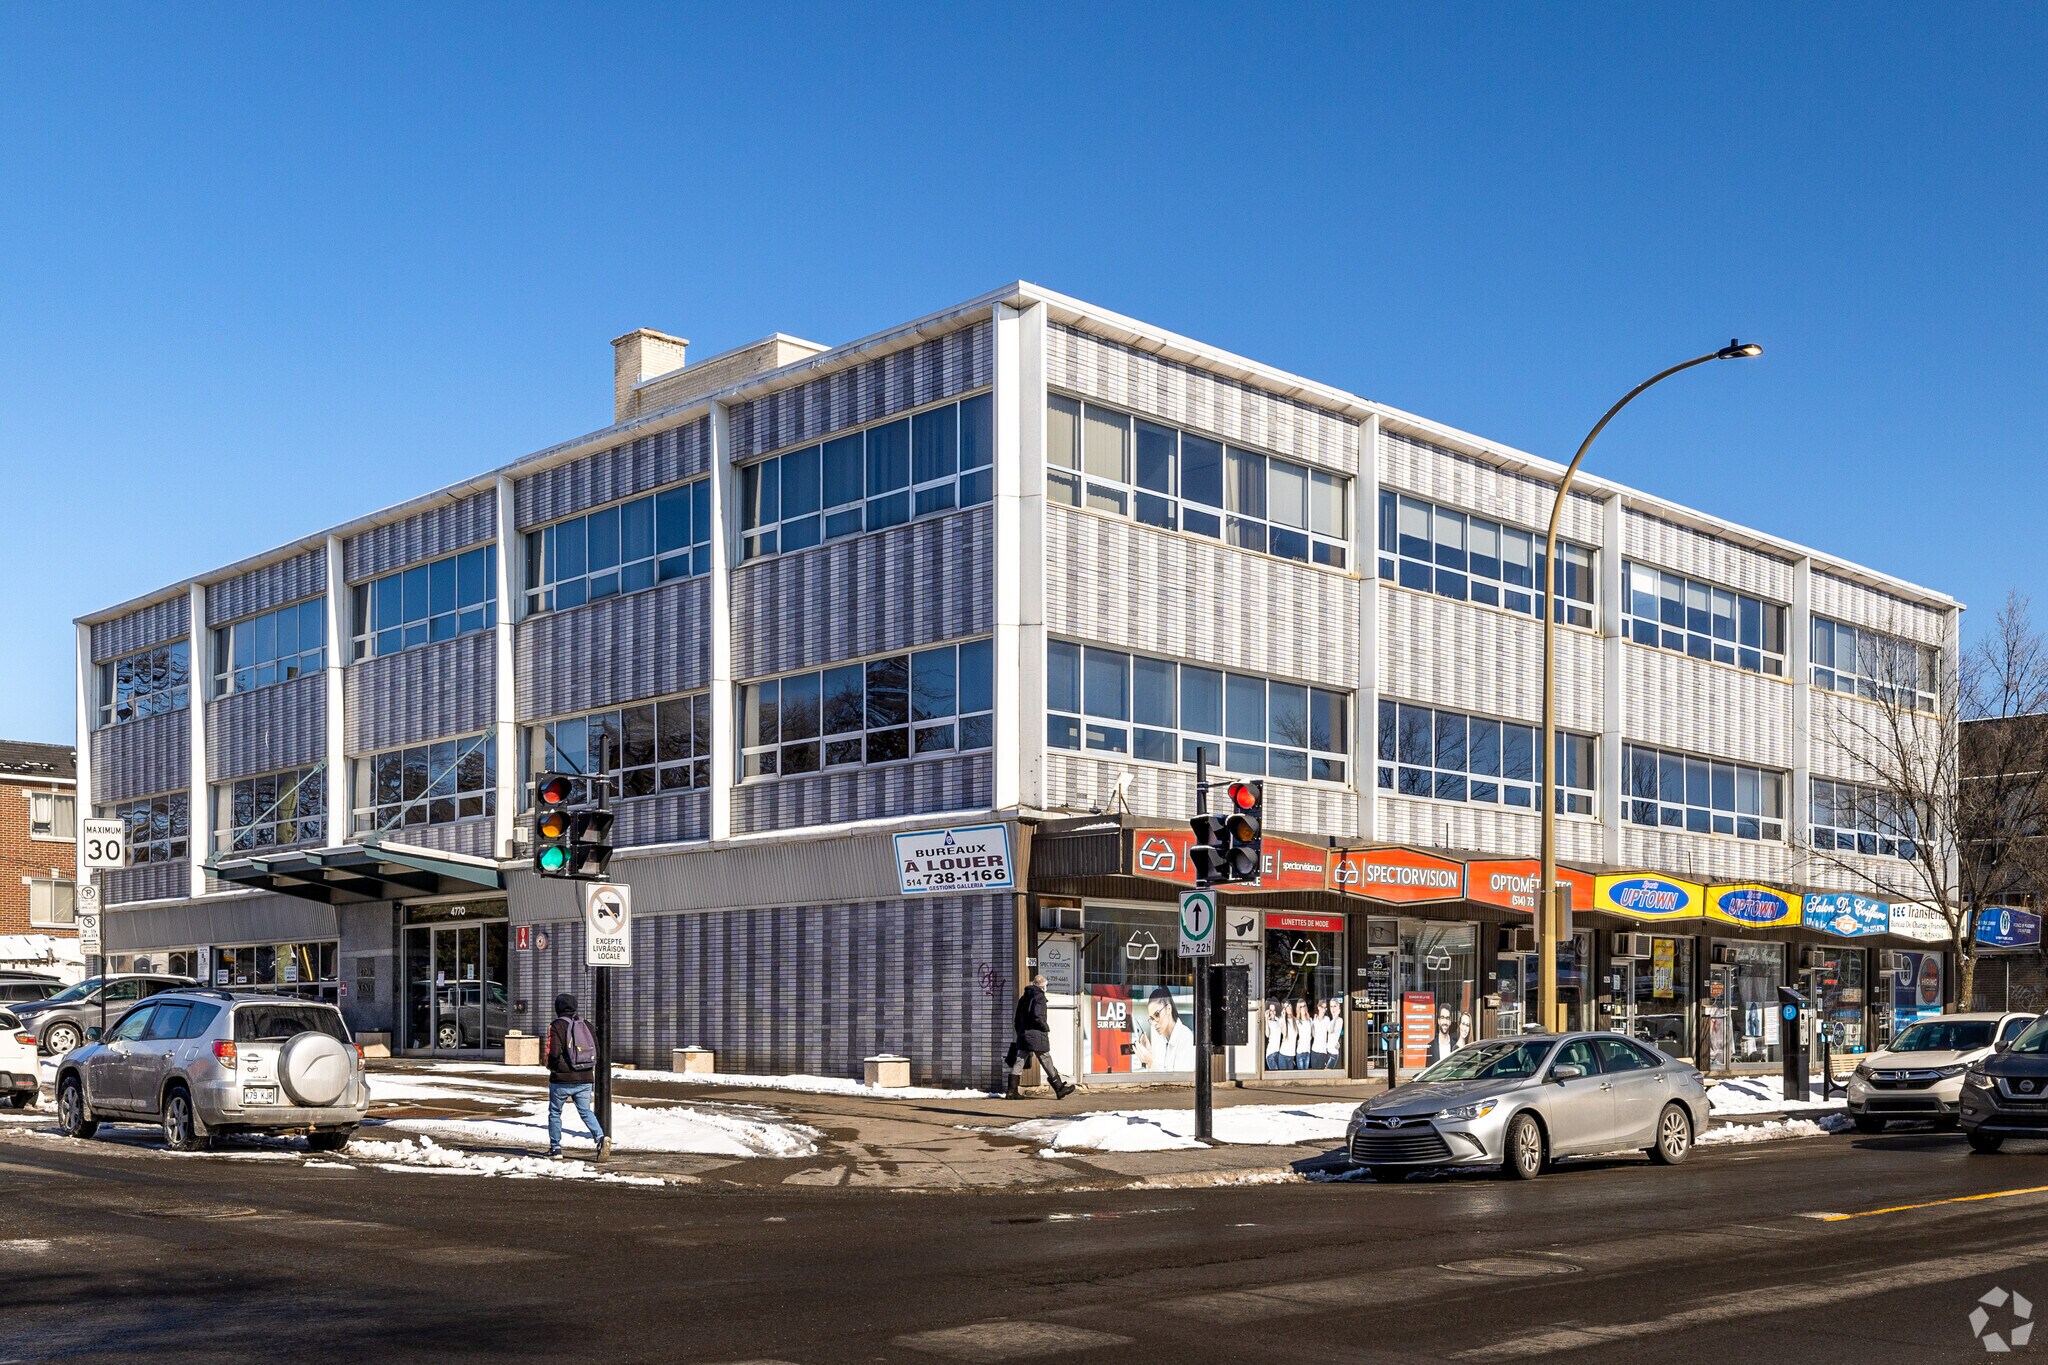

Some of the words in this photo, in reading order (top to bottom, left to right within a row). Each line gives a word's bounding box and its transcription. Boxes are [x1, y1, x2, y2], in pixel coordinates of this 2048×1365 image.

[86, 826, 121, 834] MAXIMUM
[88, 839, 120, 860] 30
[915, 844, 986, 857] BUREAUX
[926, 855, 1004, 871] LOUER
[1282, 862, 1322, 872] spectorvision.ca
[906, 878, 922, 887] 514
[922, 868, 1006, 885] 738-1166
[1367, 864, 1458, 888] SPECTORVISION
[1512, 894, 1526, 906] (514)
[1620, 888, 1679, 910] UPTOWN
[450, 906, 466, 916] 4770
[1728, 898, 1779, 918] UPTOWN
[1806, 896, 1835, 913] Salon
[1836, 896, 1852, 914] De
[1854, 898, 1886, 923] Coiffure
[1281, 917, 1307, 926] LUNETTES
[1307, 919, 1314, 927] DE
[1314, 919, 1329, 928] MODE
[1181, 944, 1190, 953] 7h
[1196, 943, 1211, 953] 22h
[1654, 967, 1673, 990] 50%
[1096, 1001, 1127, 1021] LAB
[1096, 1021, 1109, 1029] SUR
[1109, 1021, 1127, 1029] PLACE
[245, 1091, 258, 1100] K79
